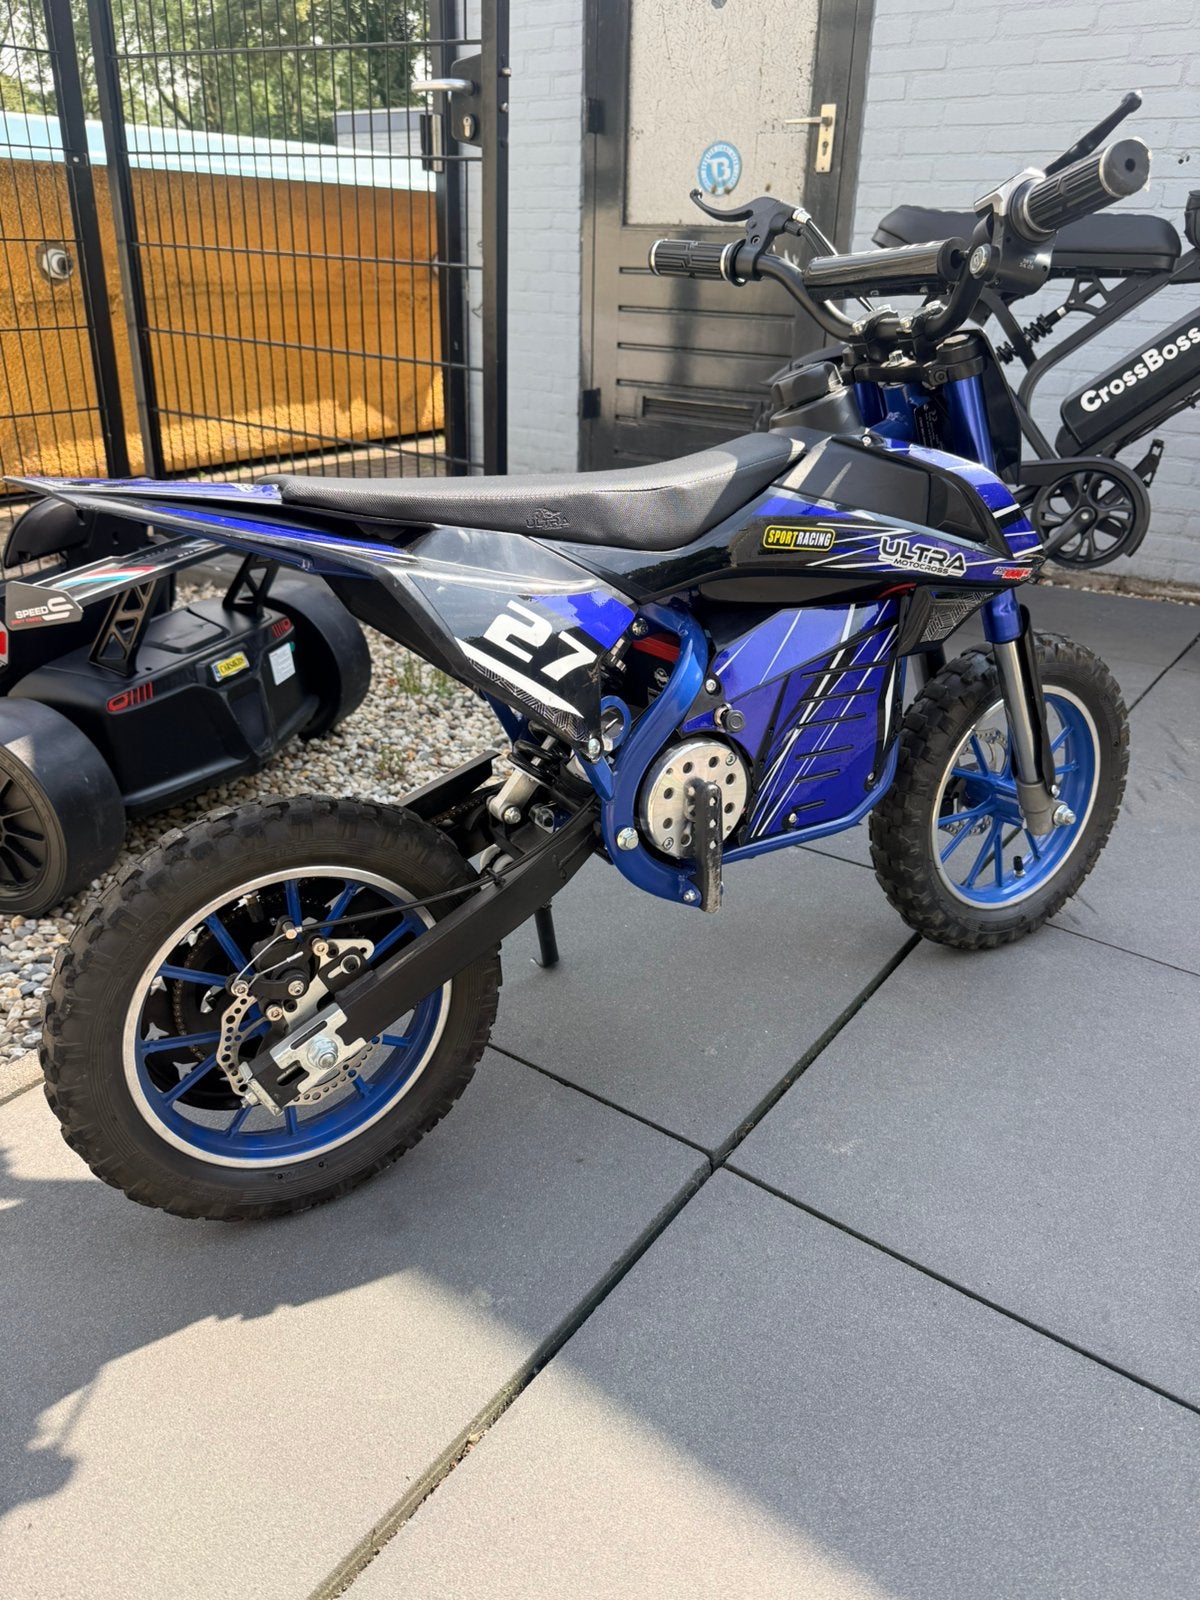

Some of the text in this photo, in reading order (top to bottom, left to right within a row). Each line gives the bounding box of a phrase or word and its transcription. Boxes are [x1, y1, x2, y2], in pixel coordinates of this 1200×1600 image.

[1080, 327, 1200, 412] CrossBoss
[526, 516, 570, 530] ULTRA
[880, 537, 966, 572] ULTRA
[893, 558, 949, 575] MOTOCROSS
[15, 606, 49, 619] SPEED
